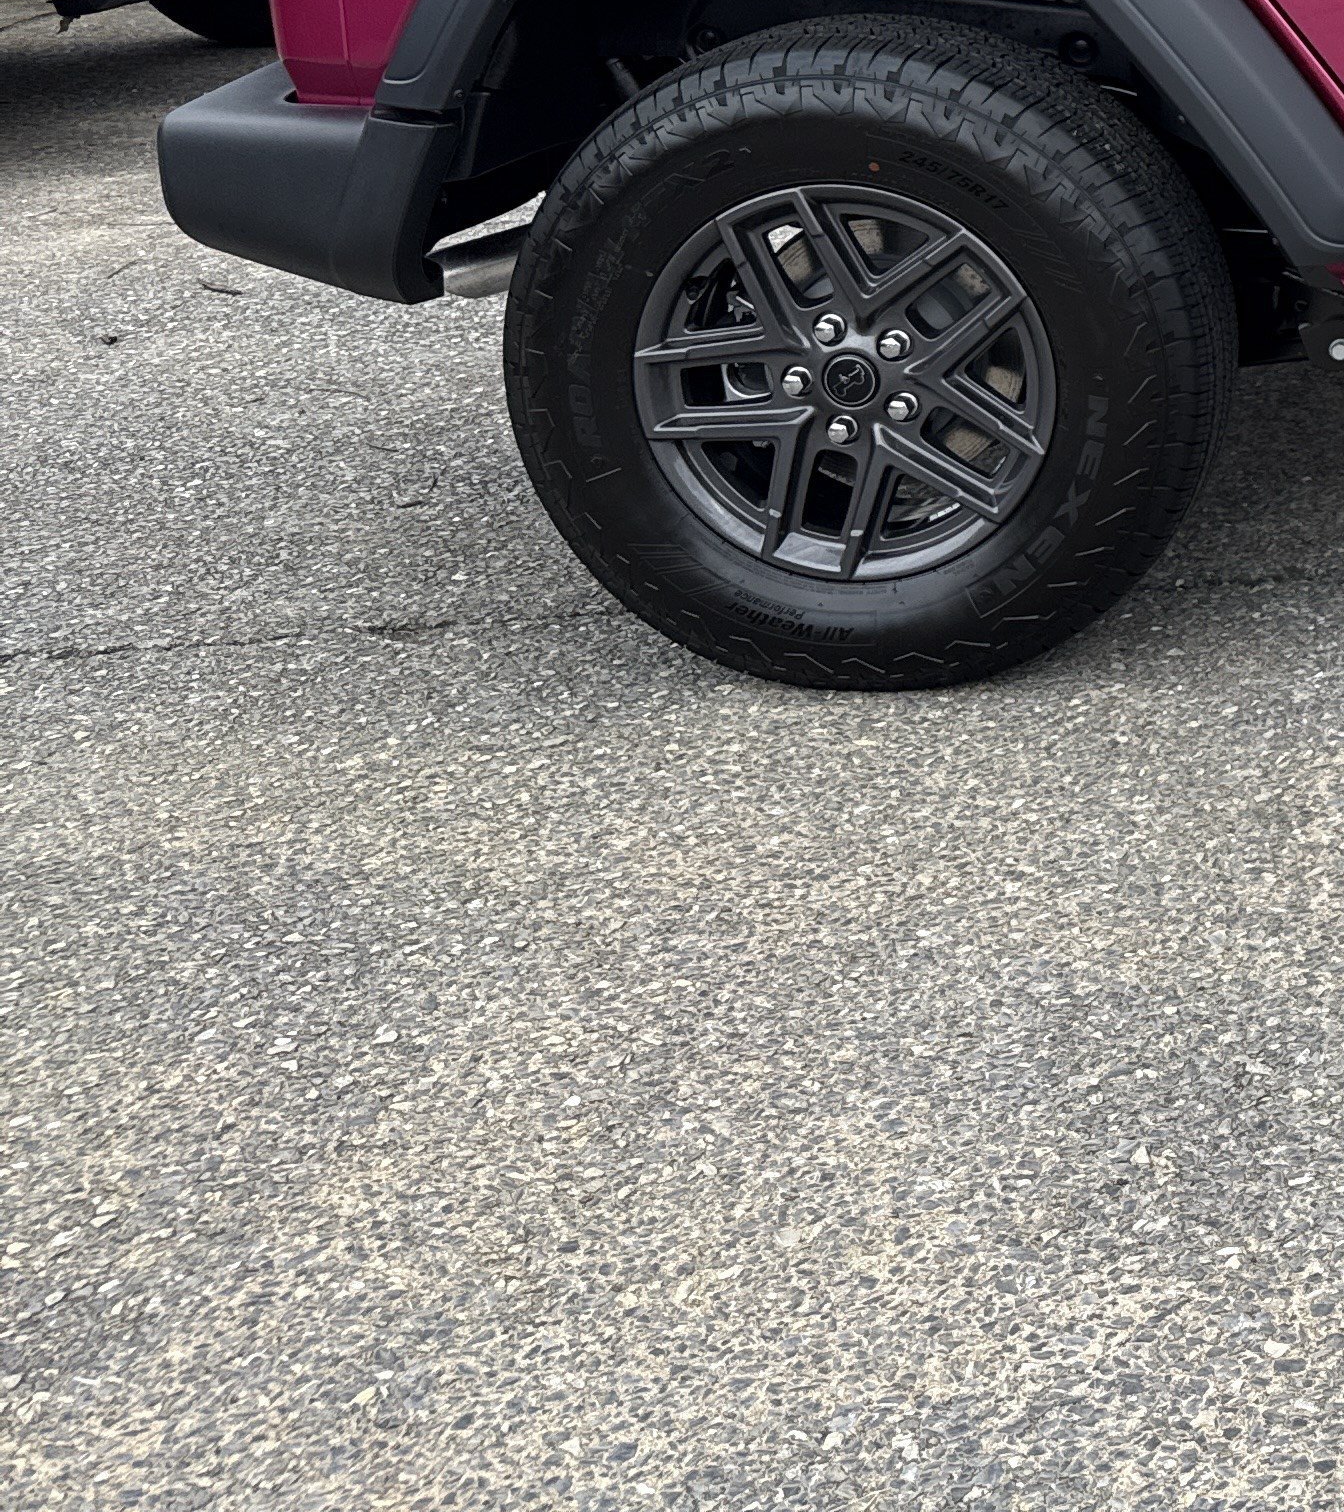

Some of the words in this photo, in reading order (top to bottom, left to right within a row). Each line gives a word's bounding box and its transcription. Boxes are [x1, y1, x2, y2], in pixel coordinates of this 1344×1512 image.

[900, 150, 1009, 209] 245/75R17
[993, 395, 1109, 597] NEXEN
[734, 589, 806, 620] Performance
